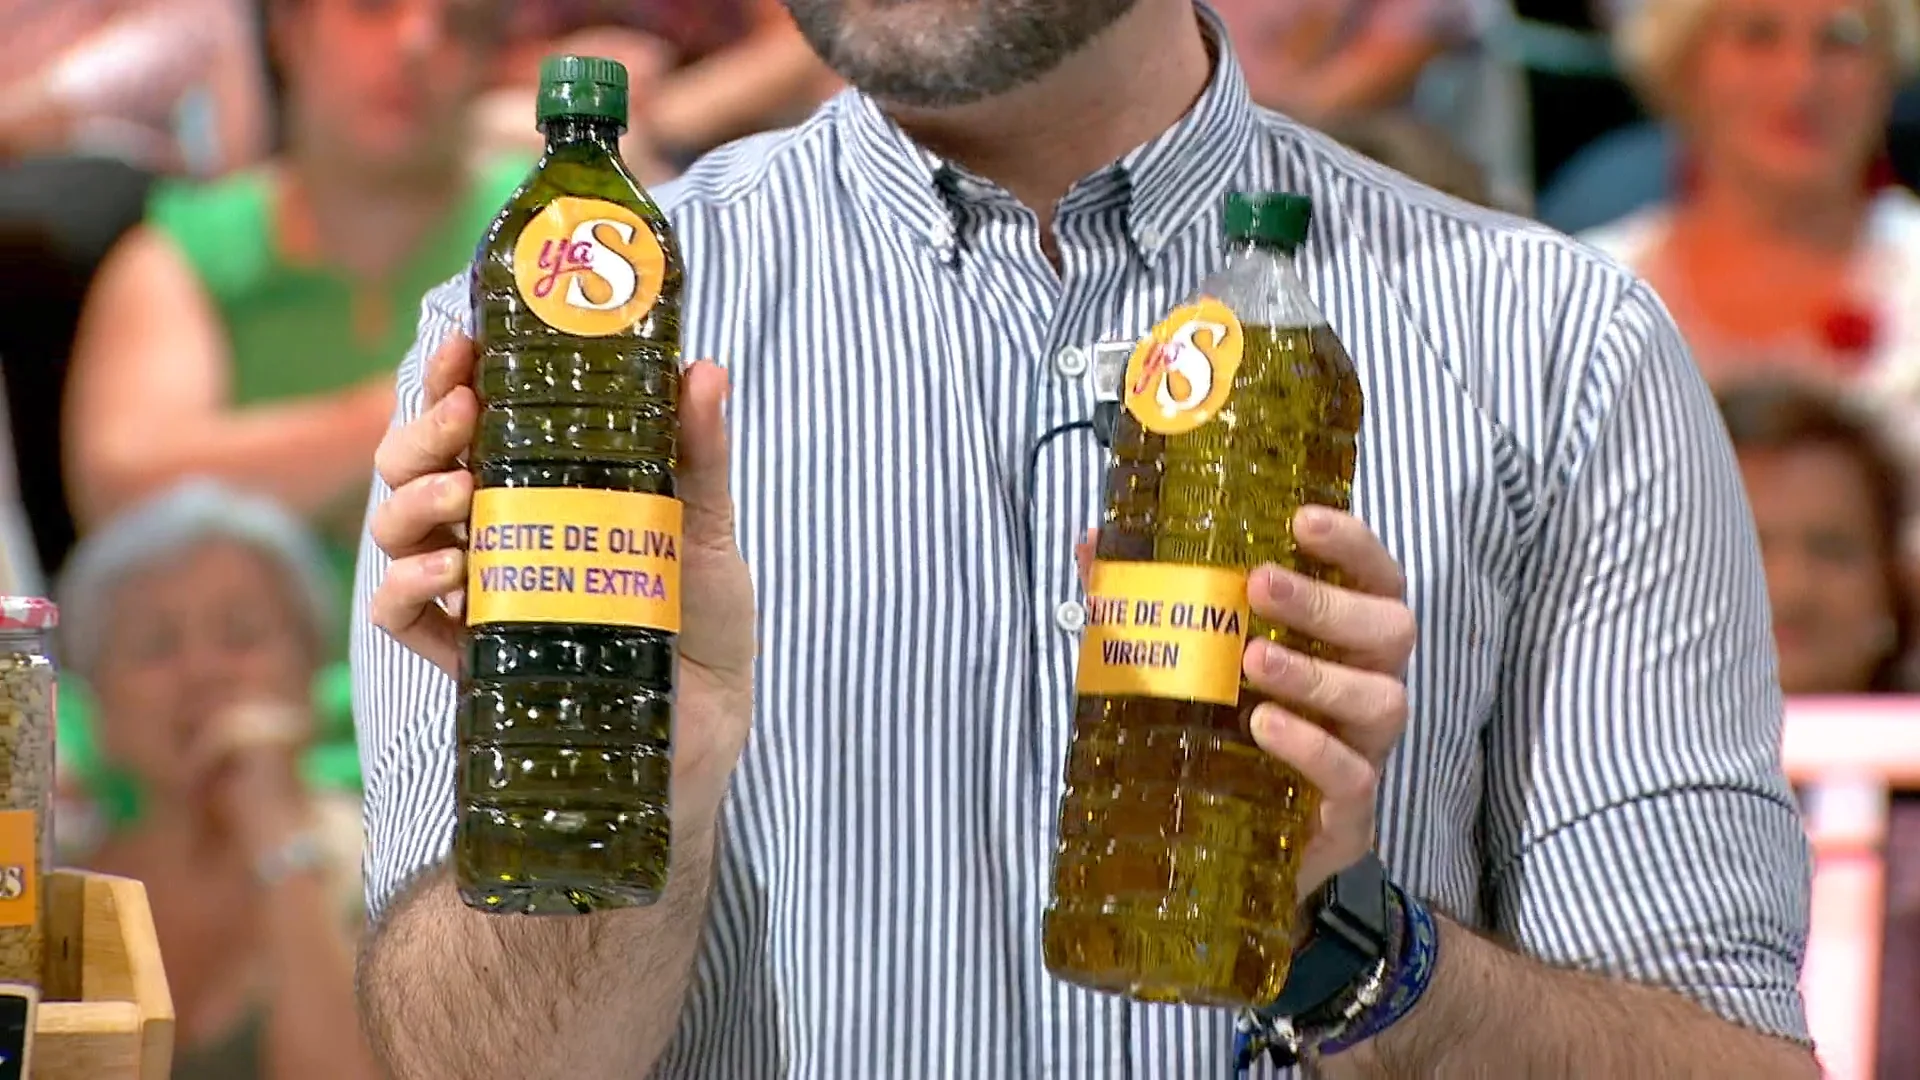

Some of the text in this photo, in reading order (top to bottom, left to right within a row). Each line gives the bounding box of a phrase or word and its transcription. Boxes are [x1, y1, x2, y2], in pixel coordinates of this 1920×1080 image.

[474, 524, 678, 561] ACEITE DE OLIVA
[480, 565, 666, 600] VIRGEN EXTRA
[1135, 599, 1163, 628] DE
[1170, 602, 1240, 636] OLIVA
[1103, 638, 1180, 669] VIRGEN
